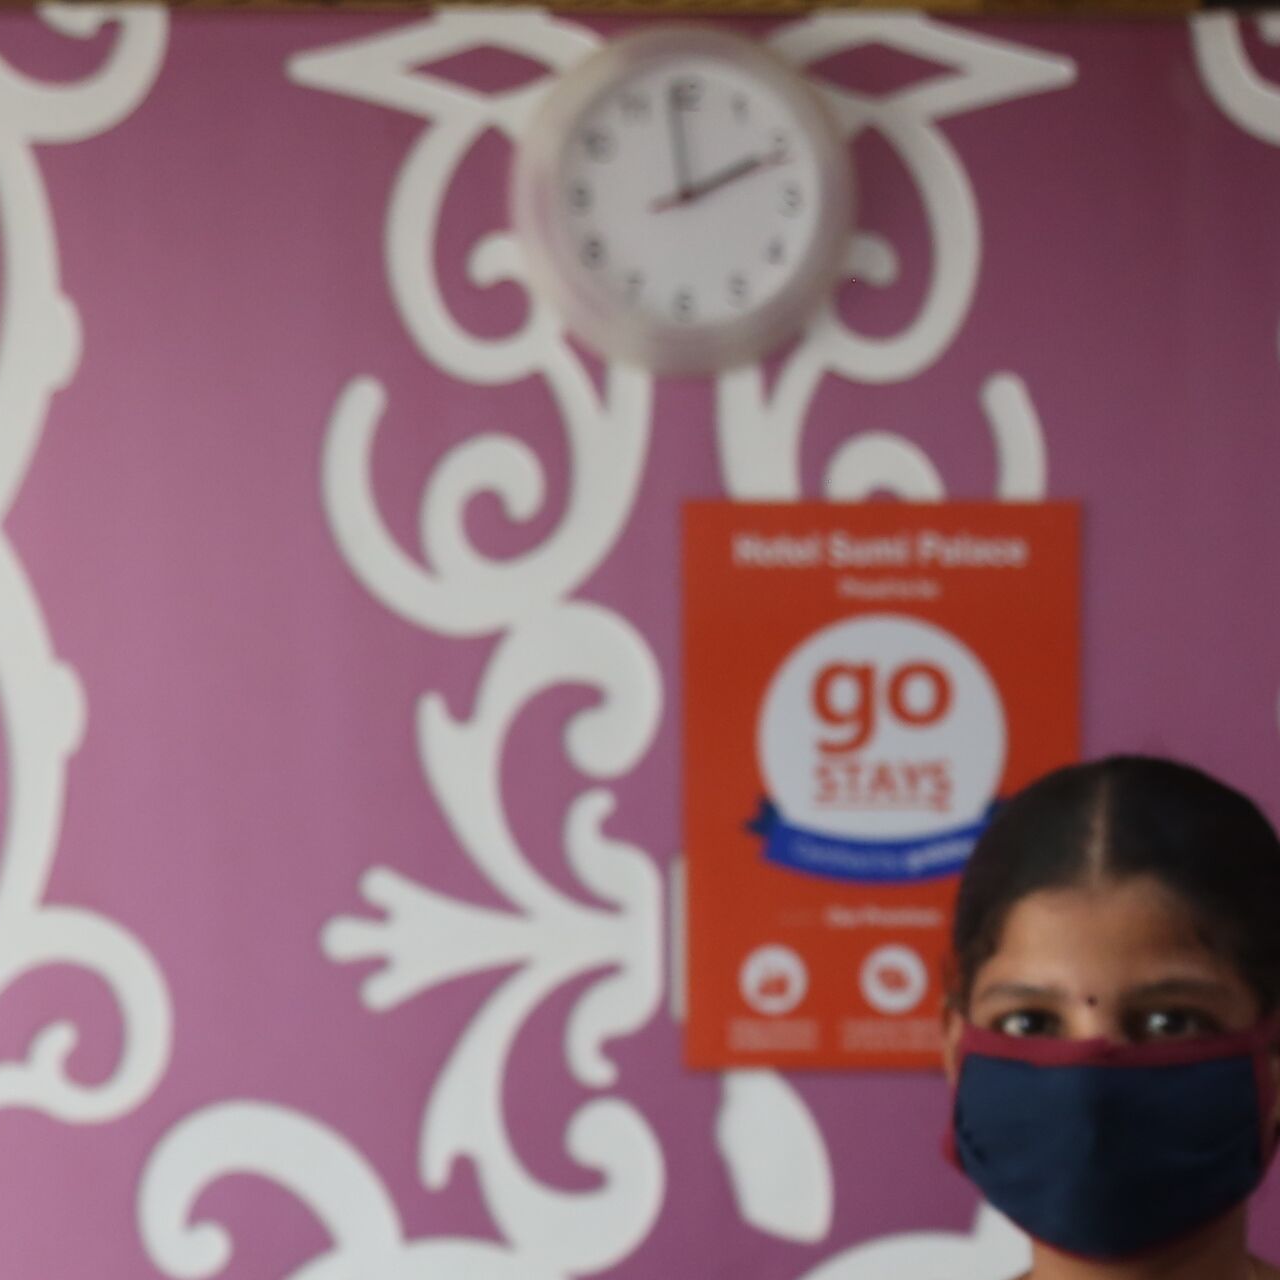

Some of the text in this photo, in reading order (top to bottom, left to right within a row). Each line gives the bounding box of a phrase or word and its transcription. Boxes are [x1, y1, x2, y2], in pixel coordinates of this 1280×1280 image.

[734, 532, 1027, 566] Hotel Sumi Palace
[813, 661, 954, 754] go
[815, 761, 951, 799] STAYS
